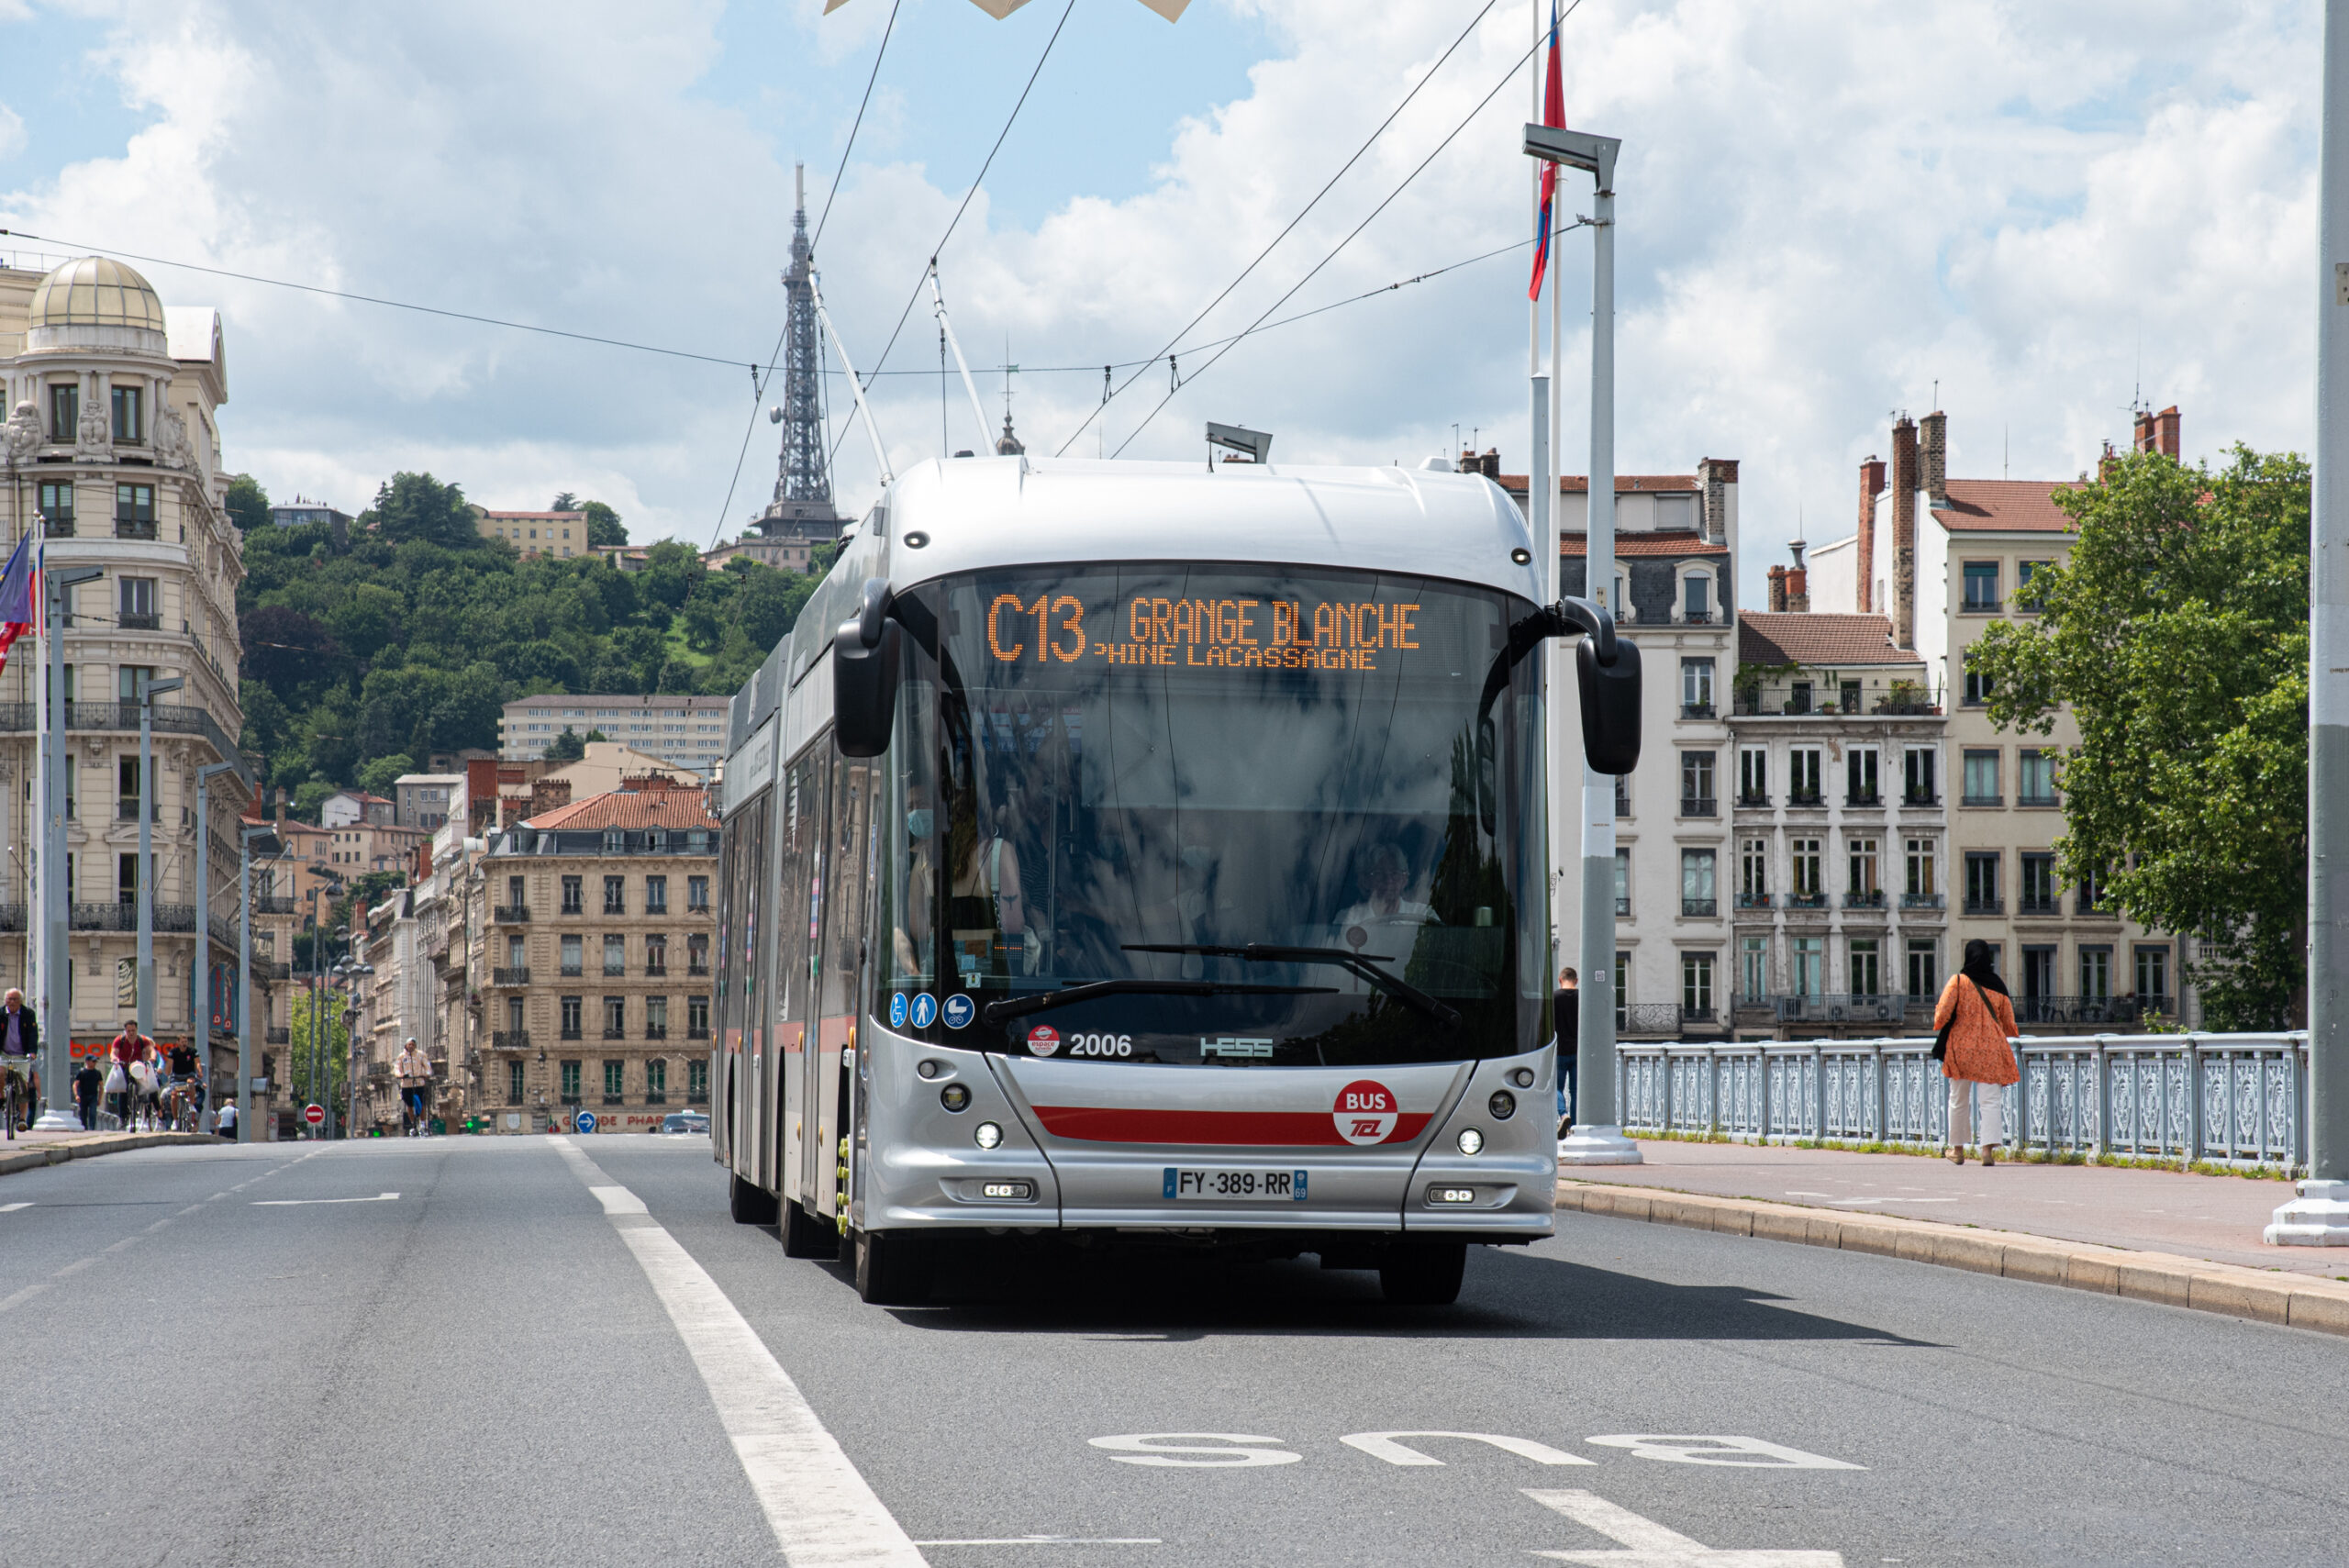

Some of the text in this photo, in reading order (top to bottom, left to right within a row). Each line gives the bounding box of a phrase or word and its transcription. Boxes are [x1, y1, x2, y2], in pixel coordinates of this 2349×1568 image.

[988, 594, 1086, 662] C13
[1130, 596, 1420, 650] GRANGE BLANCHE
[1187, 646, 1377, 670] LACASSAGNE
[1069, 1033, 1131, 1057] 2006
[1200, 1037, 1273, 1058] HESS
[1346, 1093, 1386, 1110] BUS
[562, 1116, 664, 1126] GDE PHAR
[1350, 1119, 1382, 1138] TCL
[1166, 1184, 1174, 1194] F
[1180, 1172, 1291, 1195] FY-389-RR
[1295, 1187, 1307, 1199] 69
[1086, 1431, 1872, 1470] BUS
